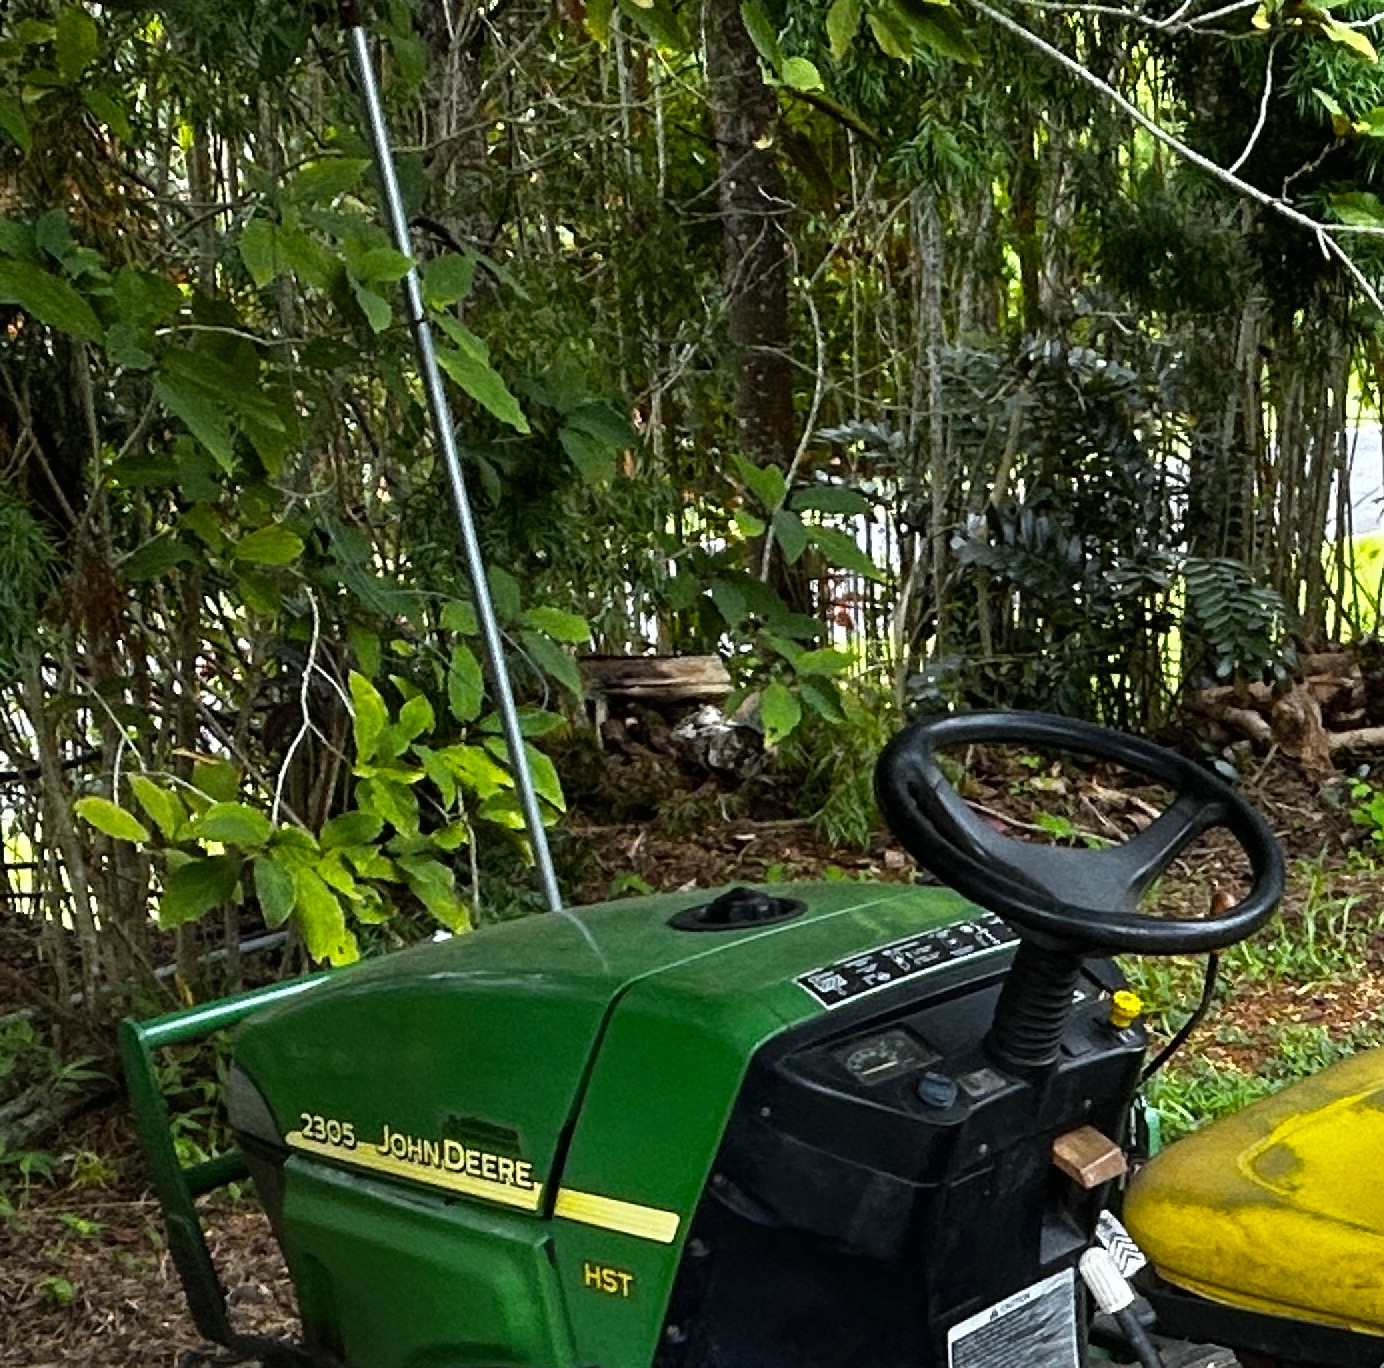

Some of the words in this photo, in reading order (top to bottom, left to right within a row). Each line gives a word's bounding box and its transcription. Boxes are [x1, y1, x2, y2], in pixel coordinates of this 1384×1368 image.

[300, 1113, 355, 1147] 2305
[377, 1124, 440, 1166] JOHN
[443, 1139, 533, 1187] DEERE
[583, 1262, 633, 1297] HST
